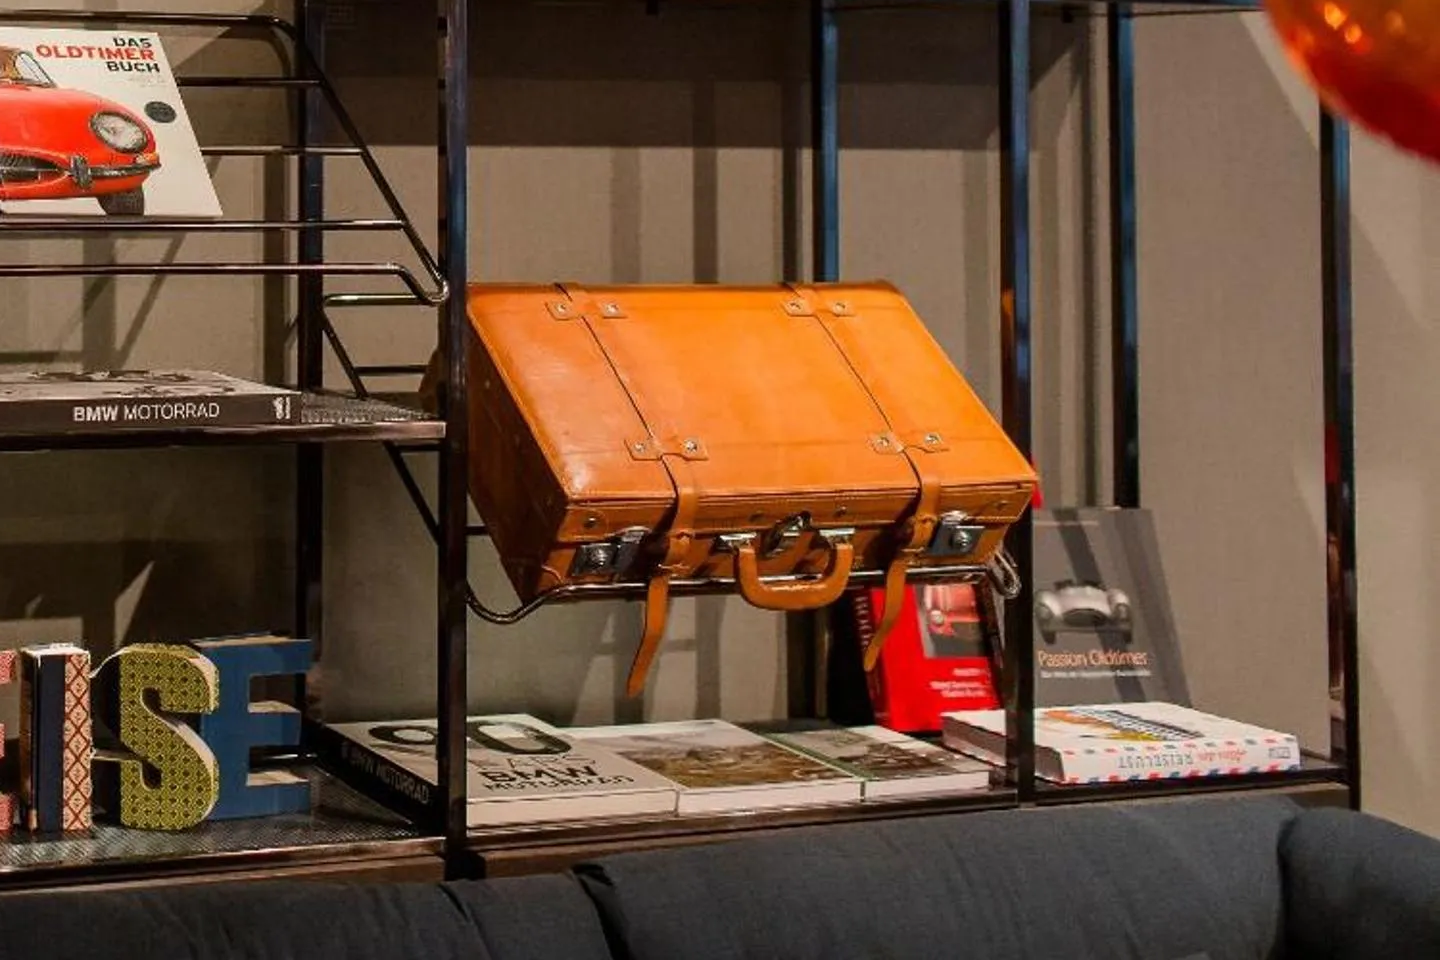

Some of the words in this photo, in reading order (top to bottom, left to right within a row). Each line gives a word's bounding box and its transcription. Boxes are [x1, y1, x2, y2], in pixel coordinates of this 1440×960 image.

[113, 37, 152, 48] DAS
[36, 44, 155, 61] OLDTIMER
[107, 60, 160, 73] BUCH
[73, 406, 118, 422] BMW
[123, 403, 220, 420] MOTORRAD
[478, 765, 599, 783] BMW
